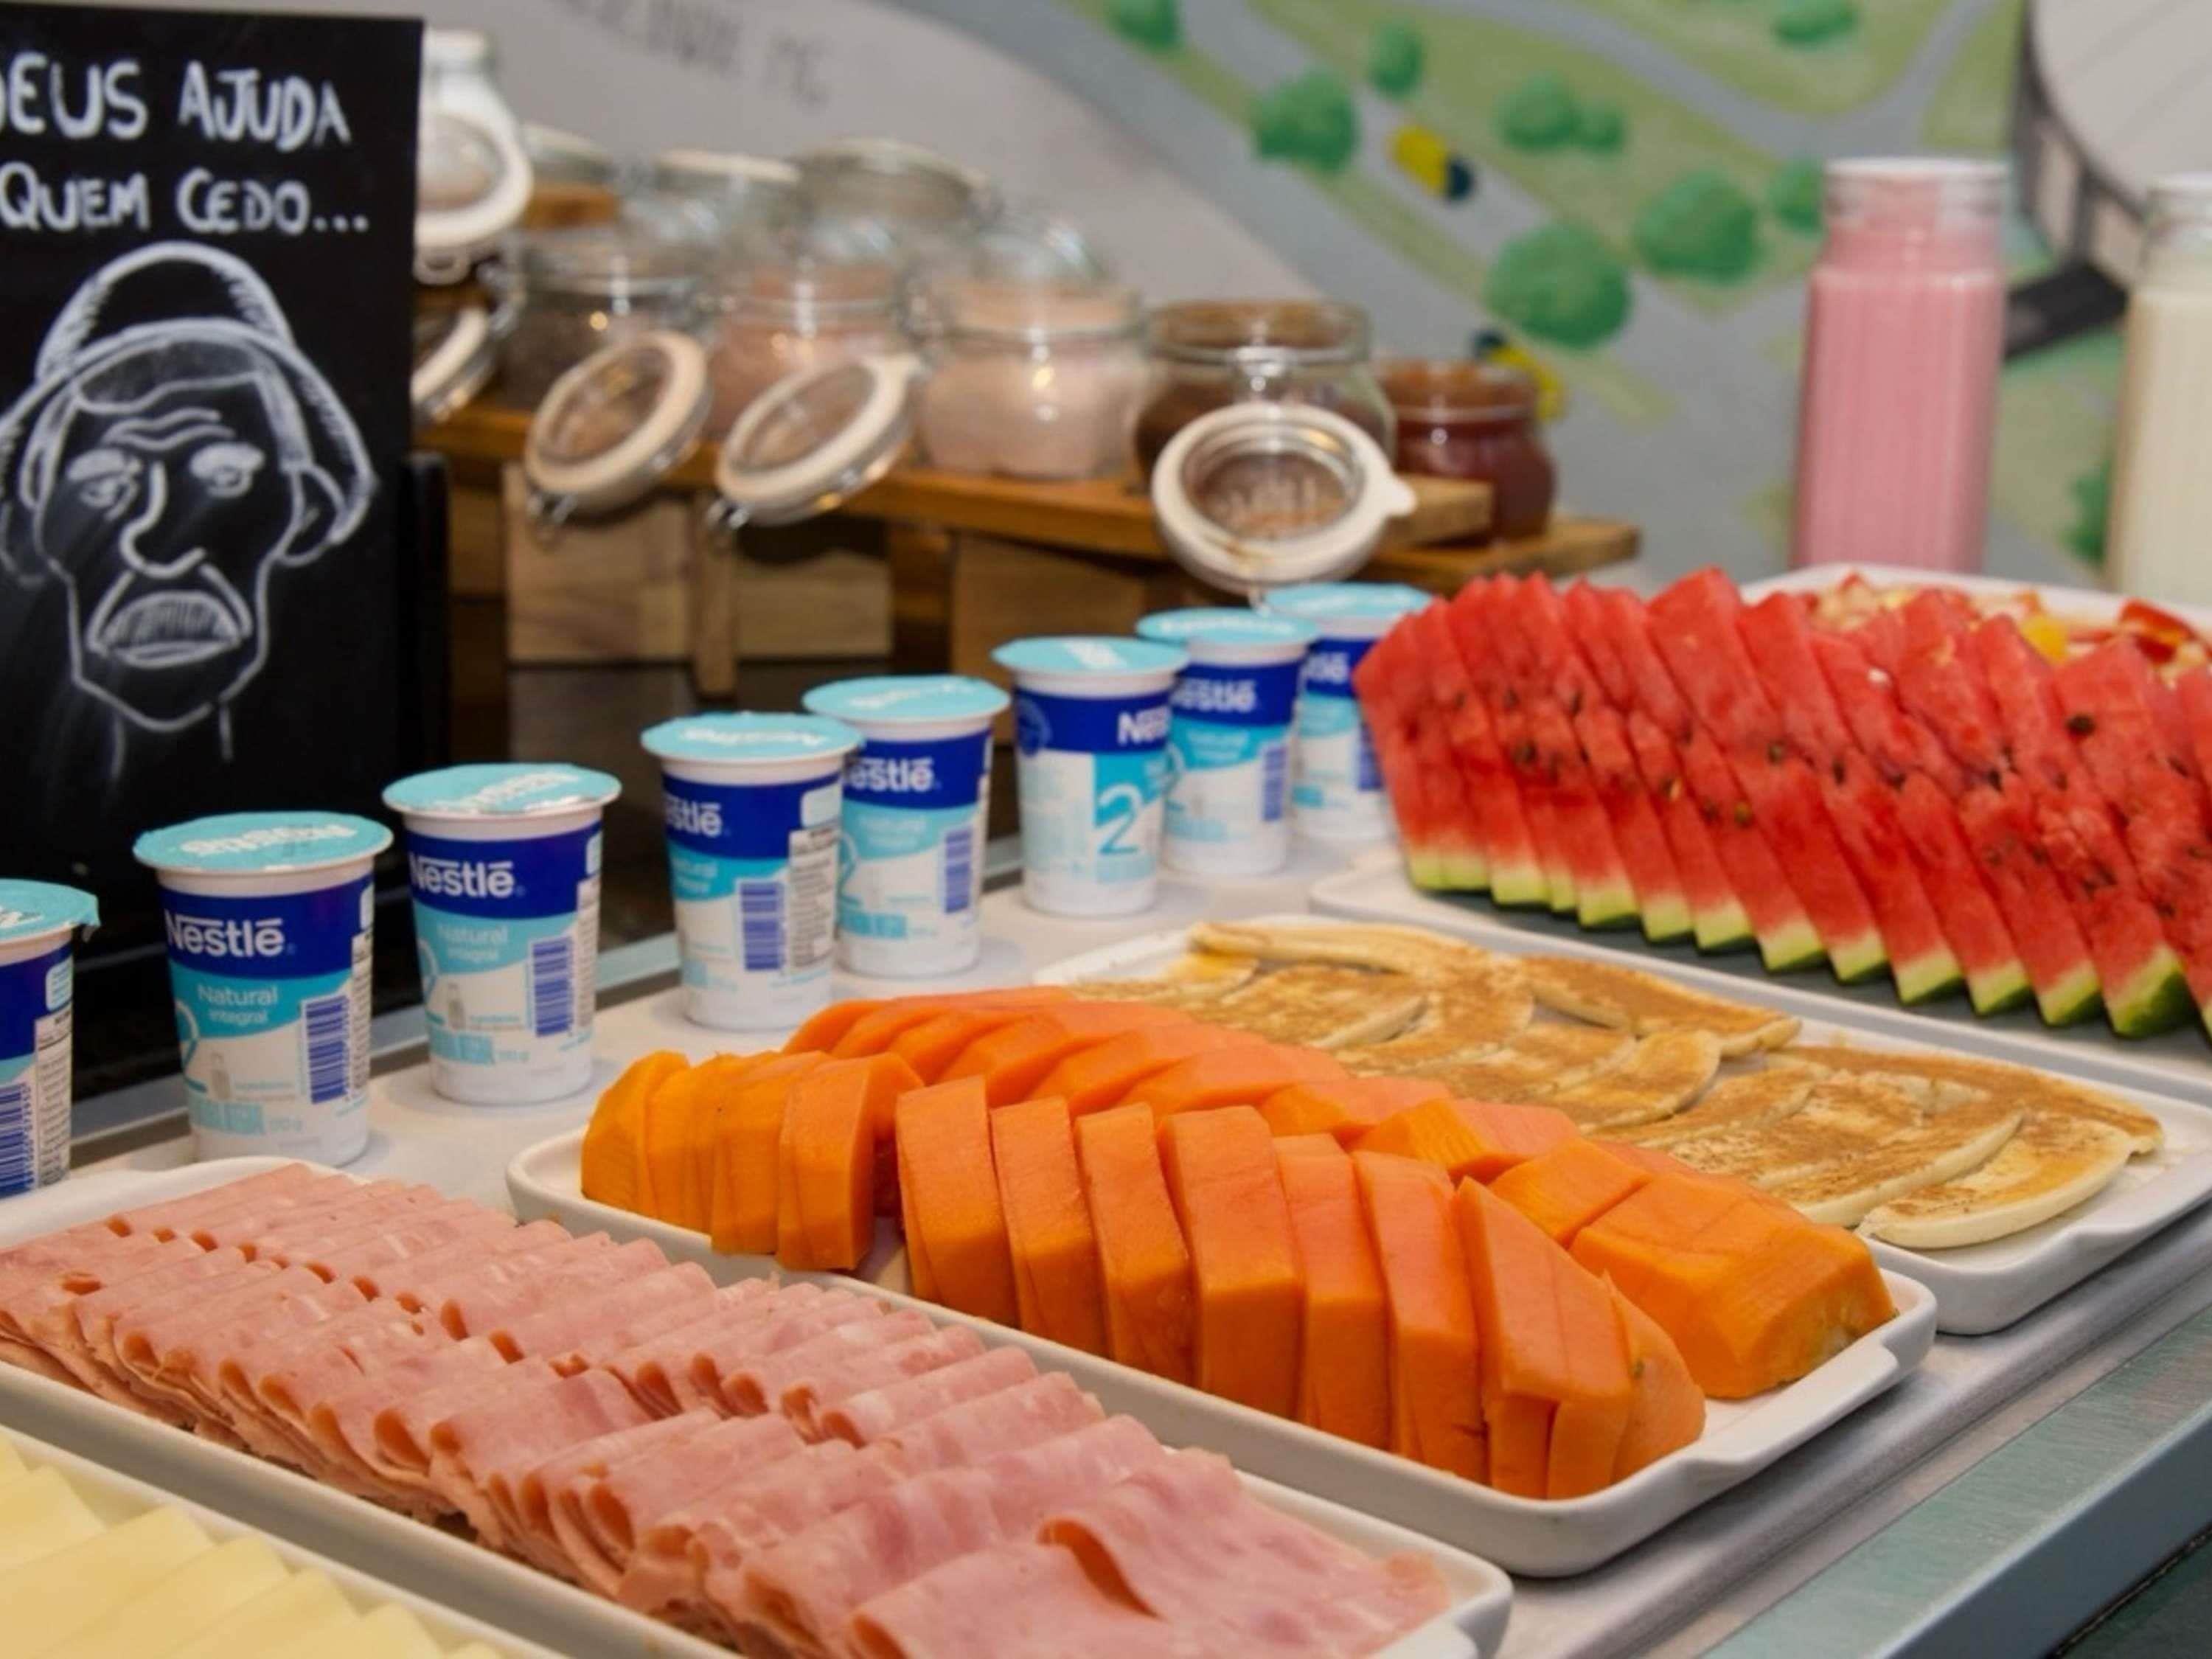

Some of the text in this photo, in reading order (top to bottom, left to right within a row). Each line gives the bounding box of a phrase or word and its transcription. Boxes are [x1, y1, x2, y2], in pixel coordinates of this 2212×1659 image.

[0, 51, 351, 153] EUS AJUDA
[0, 161, 149, 232] QUEM
[846, 757, 936, 793] estlé
[1098, 783, 1142, 856] 2
[408, 850, 515, 898] Nestlé
[164, 908, 285, 957] Nestlé
[197, 984, 279, 1006] Natural
